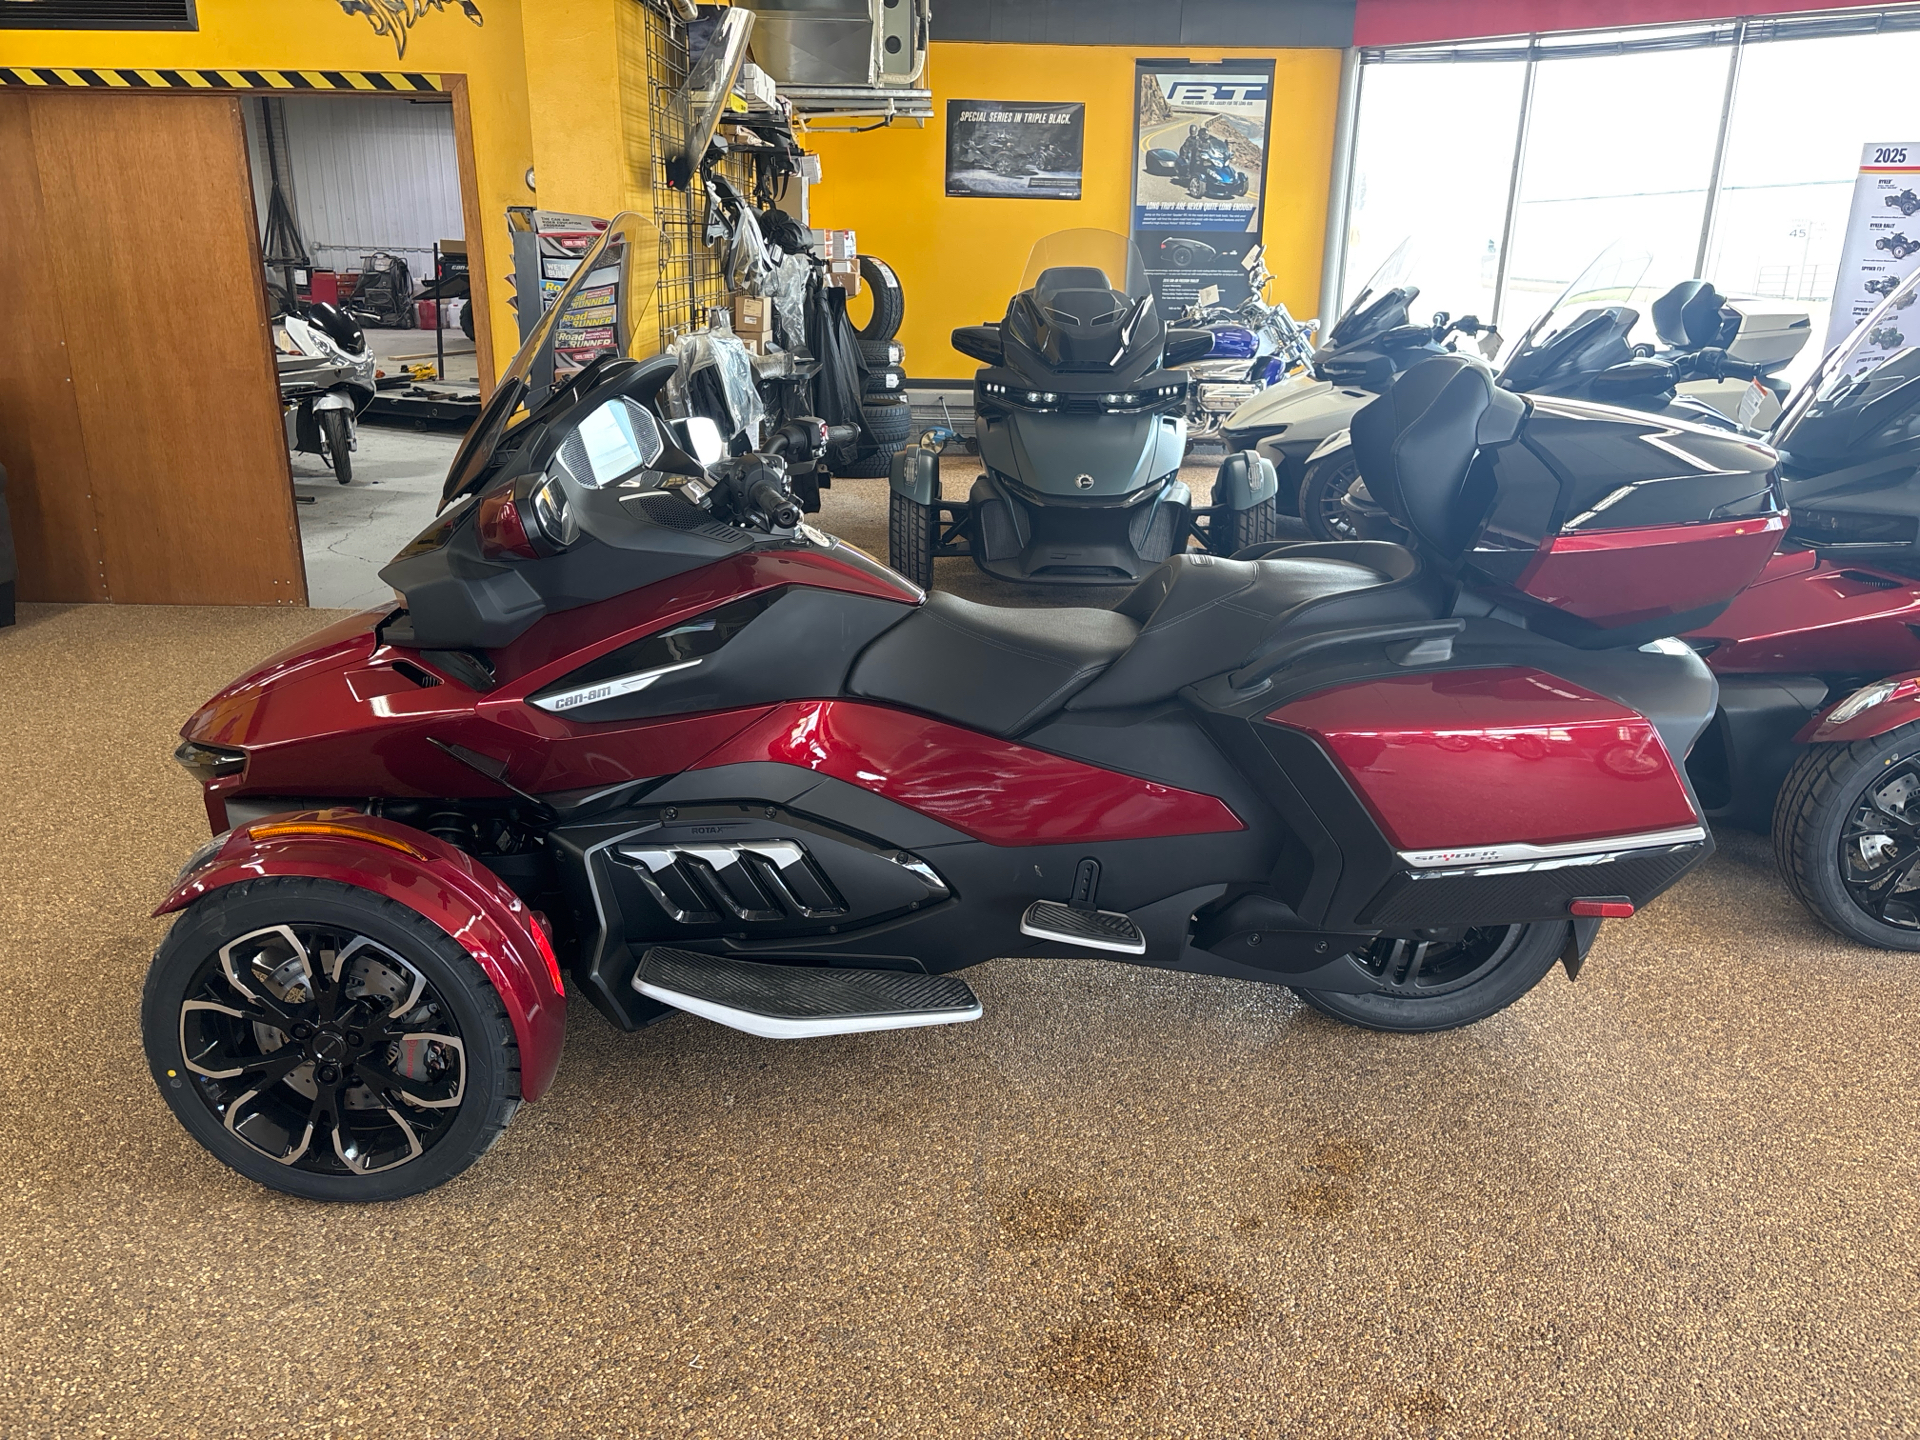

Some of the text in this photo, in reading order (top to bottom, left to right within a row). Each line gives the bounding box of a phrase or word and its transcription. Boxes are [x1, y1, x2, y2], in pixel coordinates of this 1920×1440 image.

[960, 111, 987, 122] SPECIAL
[988, 113, 1012, 123] SERIES
[1014, 113, 1022, 123] IN
[1024, 113, 1047, 123] TRIPLE
[1874, 148, 1908, 163] 2025
[1789, 229, 1806, 238] 45
[562, 311, 588, 322] Road
[573, 317, 612, 328] RUNNER
[559, 332, 586, 341] Road
[570, 339, 611, 348] RUNNER
[555, 686, 611, 709] can-am
[692, 826, 723, 834] ROTAX
[1414, 851, 1497, 861] SPYDER
